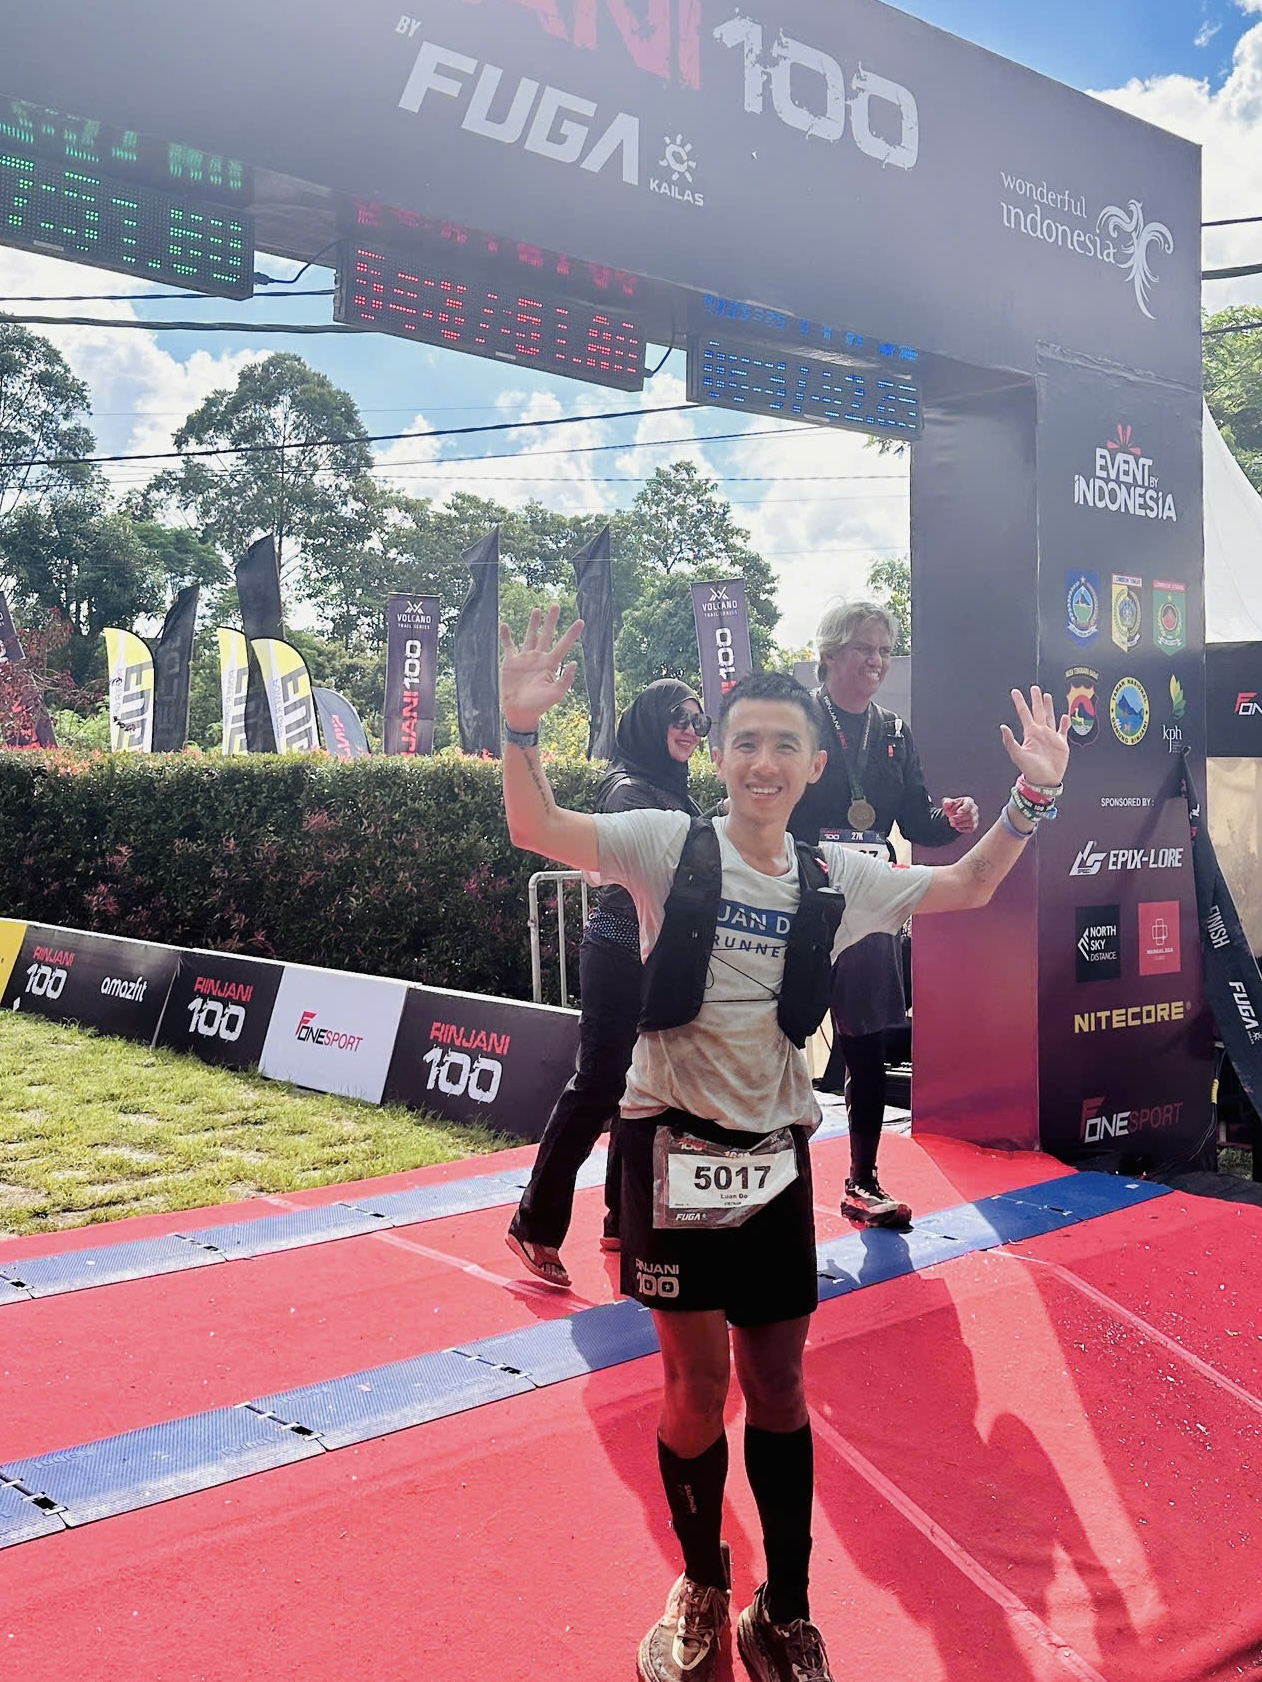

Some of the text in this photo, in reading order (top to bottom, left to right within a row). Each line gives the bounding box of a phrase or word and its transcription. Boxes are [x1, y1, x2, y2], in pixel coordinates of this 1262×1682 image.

[395, 15, 422, 37] BY
[713, 8, 919, 171] 100
[398, 41, 640, 186] FUGA
[650, 178, 704, 206] KAILAS
[1001, 172, 1087, 218] wonderful
[1001, 202, 1118, 264] indonesia
[1095, 447, 1159, 488] EVENT BY
[397, 613, 432, 624] VOLCANO
[702, 600, 738, 612] VOLCANO
[715, 627, 736, 679] 100
[401, 639, 422, 757] JANI 100
[1162, 724, 1182, 753] kph
[1101, 797, 1141, 807] SPONSORED
[851, 832, 864, 841] 27K
[1108, 848, 1184, 871] EPIX-LORE
[1090, 925, 1117, 937] NORTH
[1207, 905, 1231, 949] FINISH
[33, 946, 76, 967] RINJANI
[713, 934, 786, 960] RUNNE
[1090, 939, 1106, 951] SKY
[1090, 951, 1118, 962] DISTANCE
[25, 962, 68, 1000] 100
[101, 976, 147, 1002] amazfit
[194, 976, 254, 1002] RINJANI
[188, 995, 246, 1043] 100
[1074, 1001, 1184, 1033] NITECORE
[430, 1021, 511, 1056] RINJANI
[423, 1044, 503, 1104] 100
[694, 1166, 771, 1190] 5017
[675, 1213, 701, 1221] FUGA
[636, 1272, 680, 1298] 100
